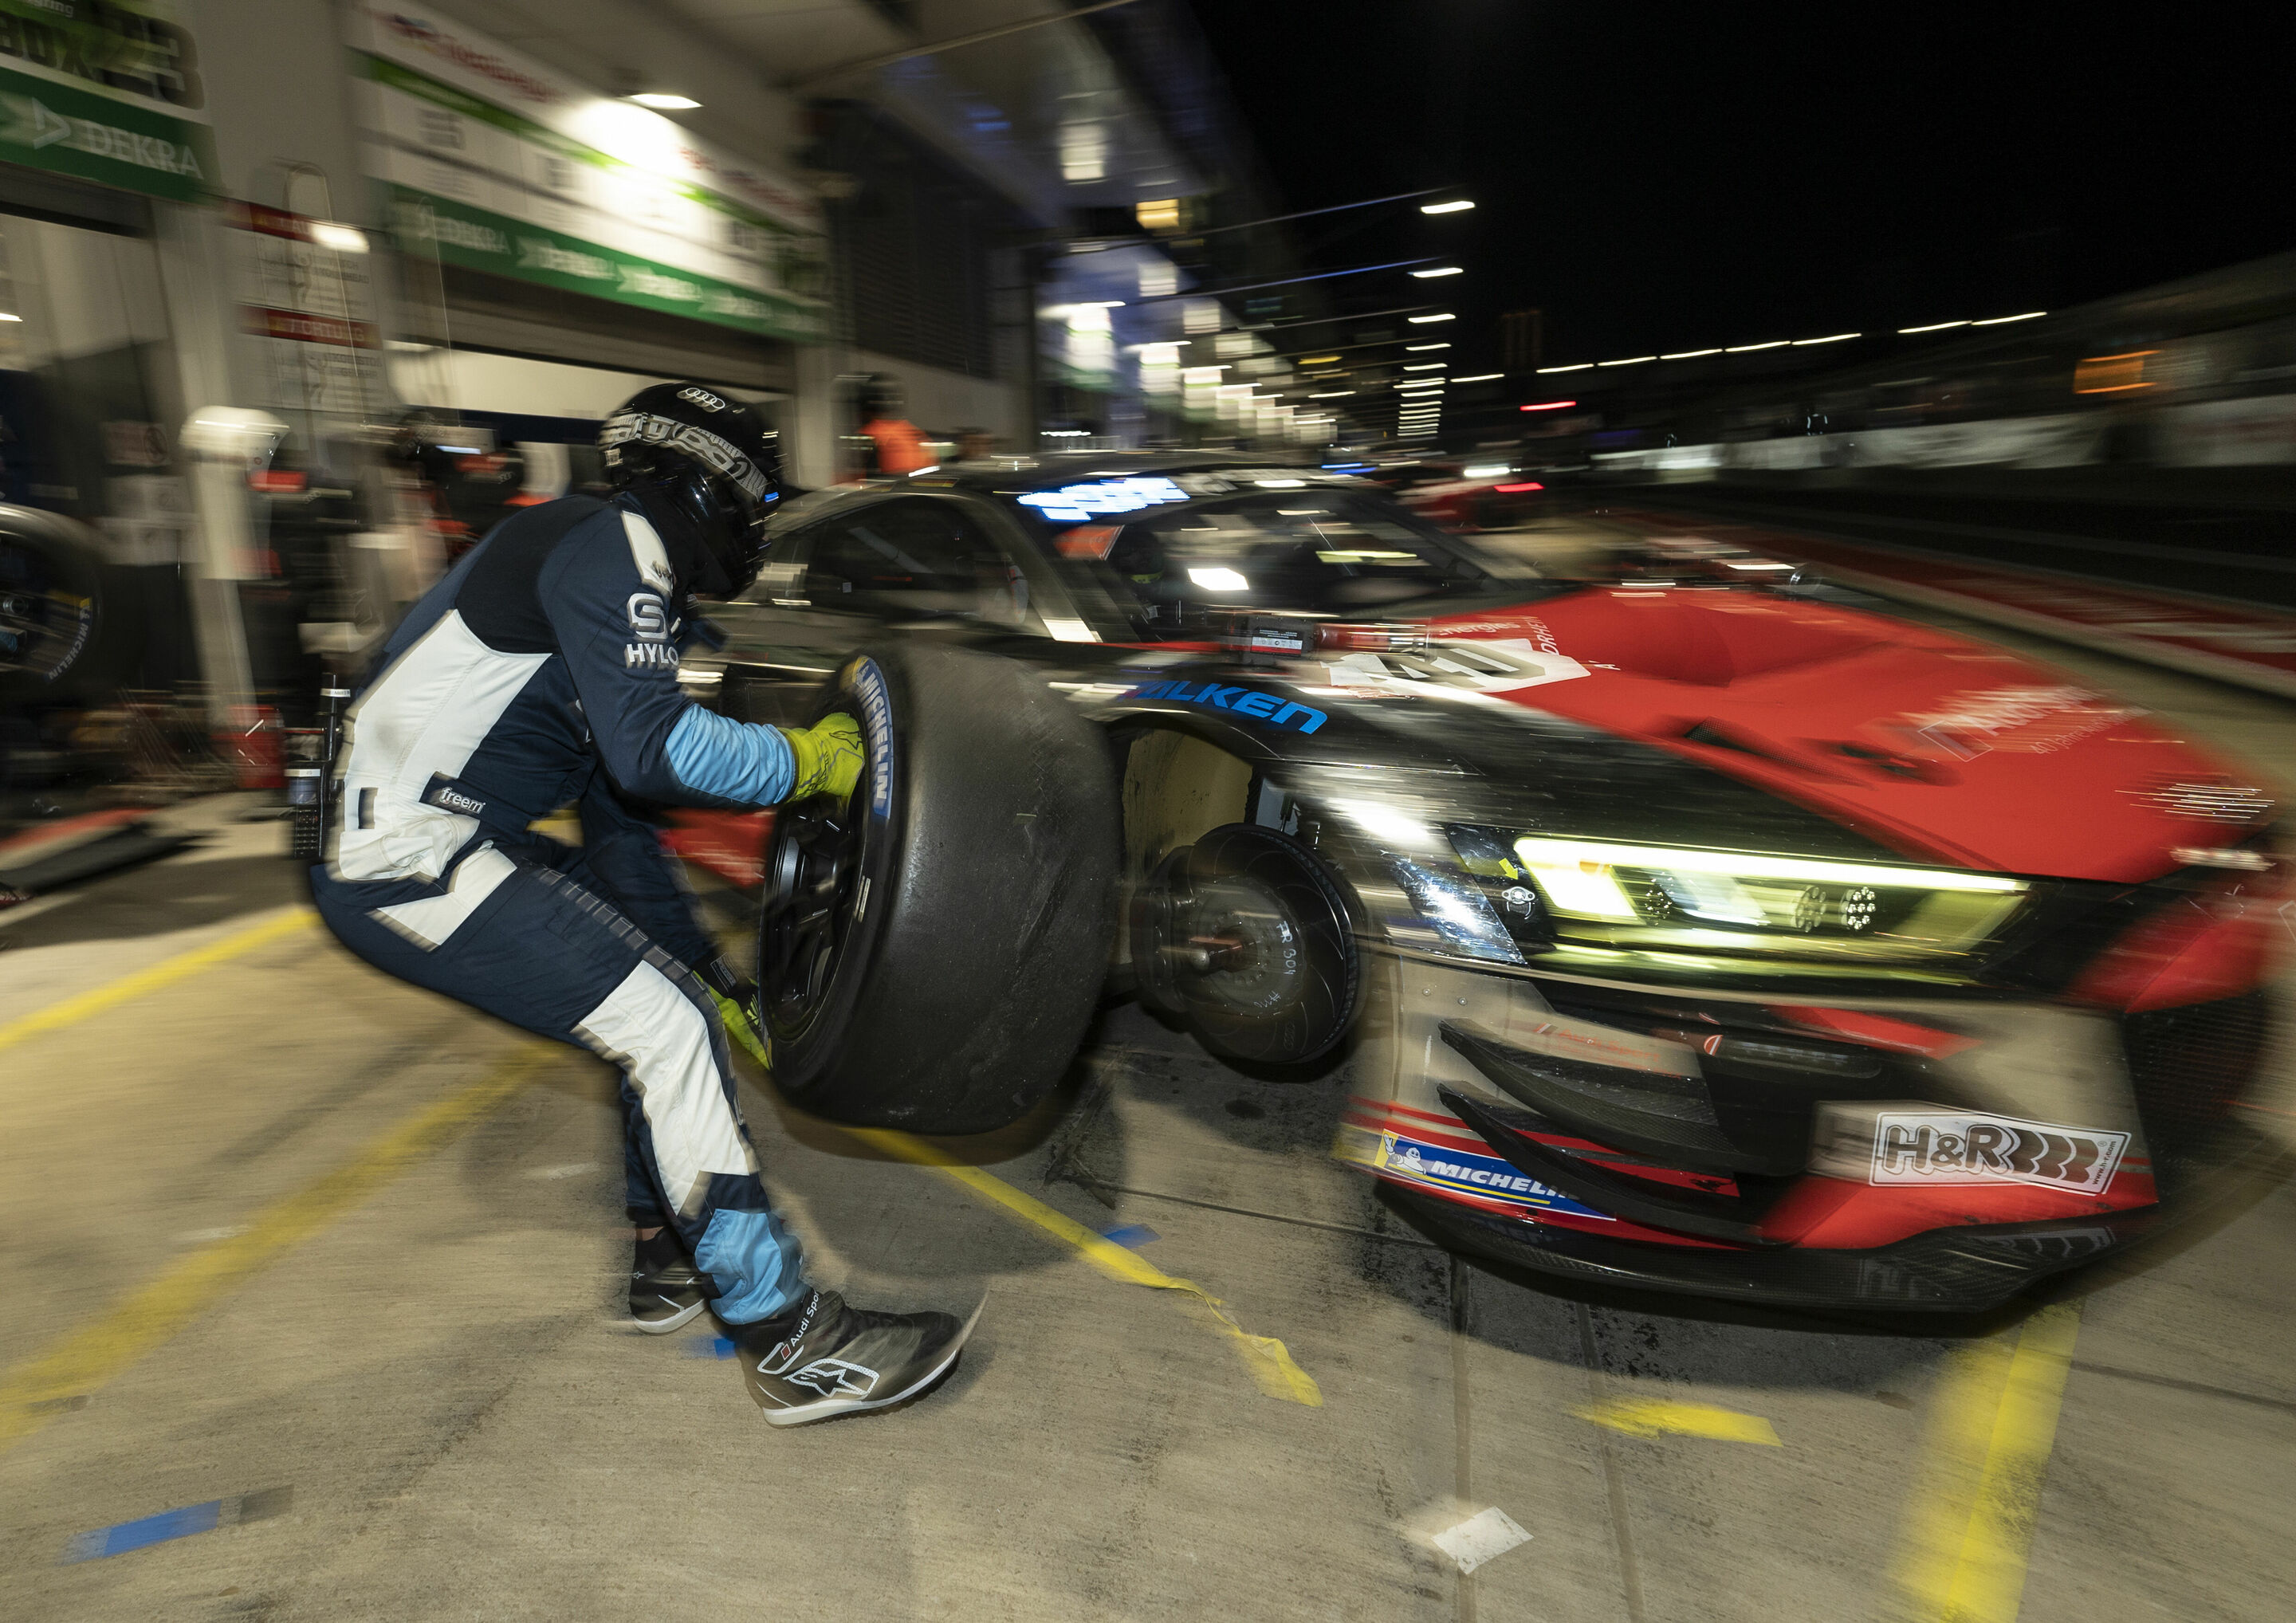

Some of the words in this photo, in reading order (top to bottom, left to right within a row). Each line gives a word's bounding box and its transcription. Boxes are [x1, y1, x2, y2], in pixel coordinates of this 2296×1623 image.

[82, 120, 204, 180] DEKRA
[49, 623, 88, 680] MICHELIN
[1439, 622, 1521, 636] nergies
[860, 672, 889, 800] MICHELIN
[441, 788, 482, 813] freem
[1883, 1125, 2009, 1175] H&R
[1431, 1161, 1567, 1199] MICHEL
[790, 1318, 810, 1347] Audi
[806, 1290, 820, 1318] Spor
